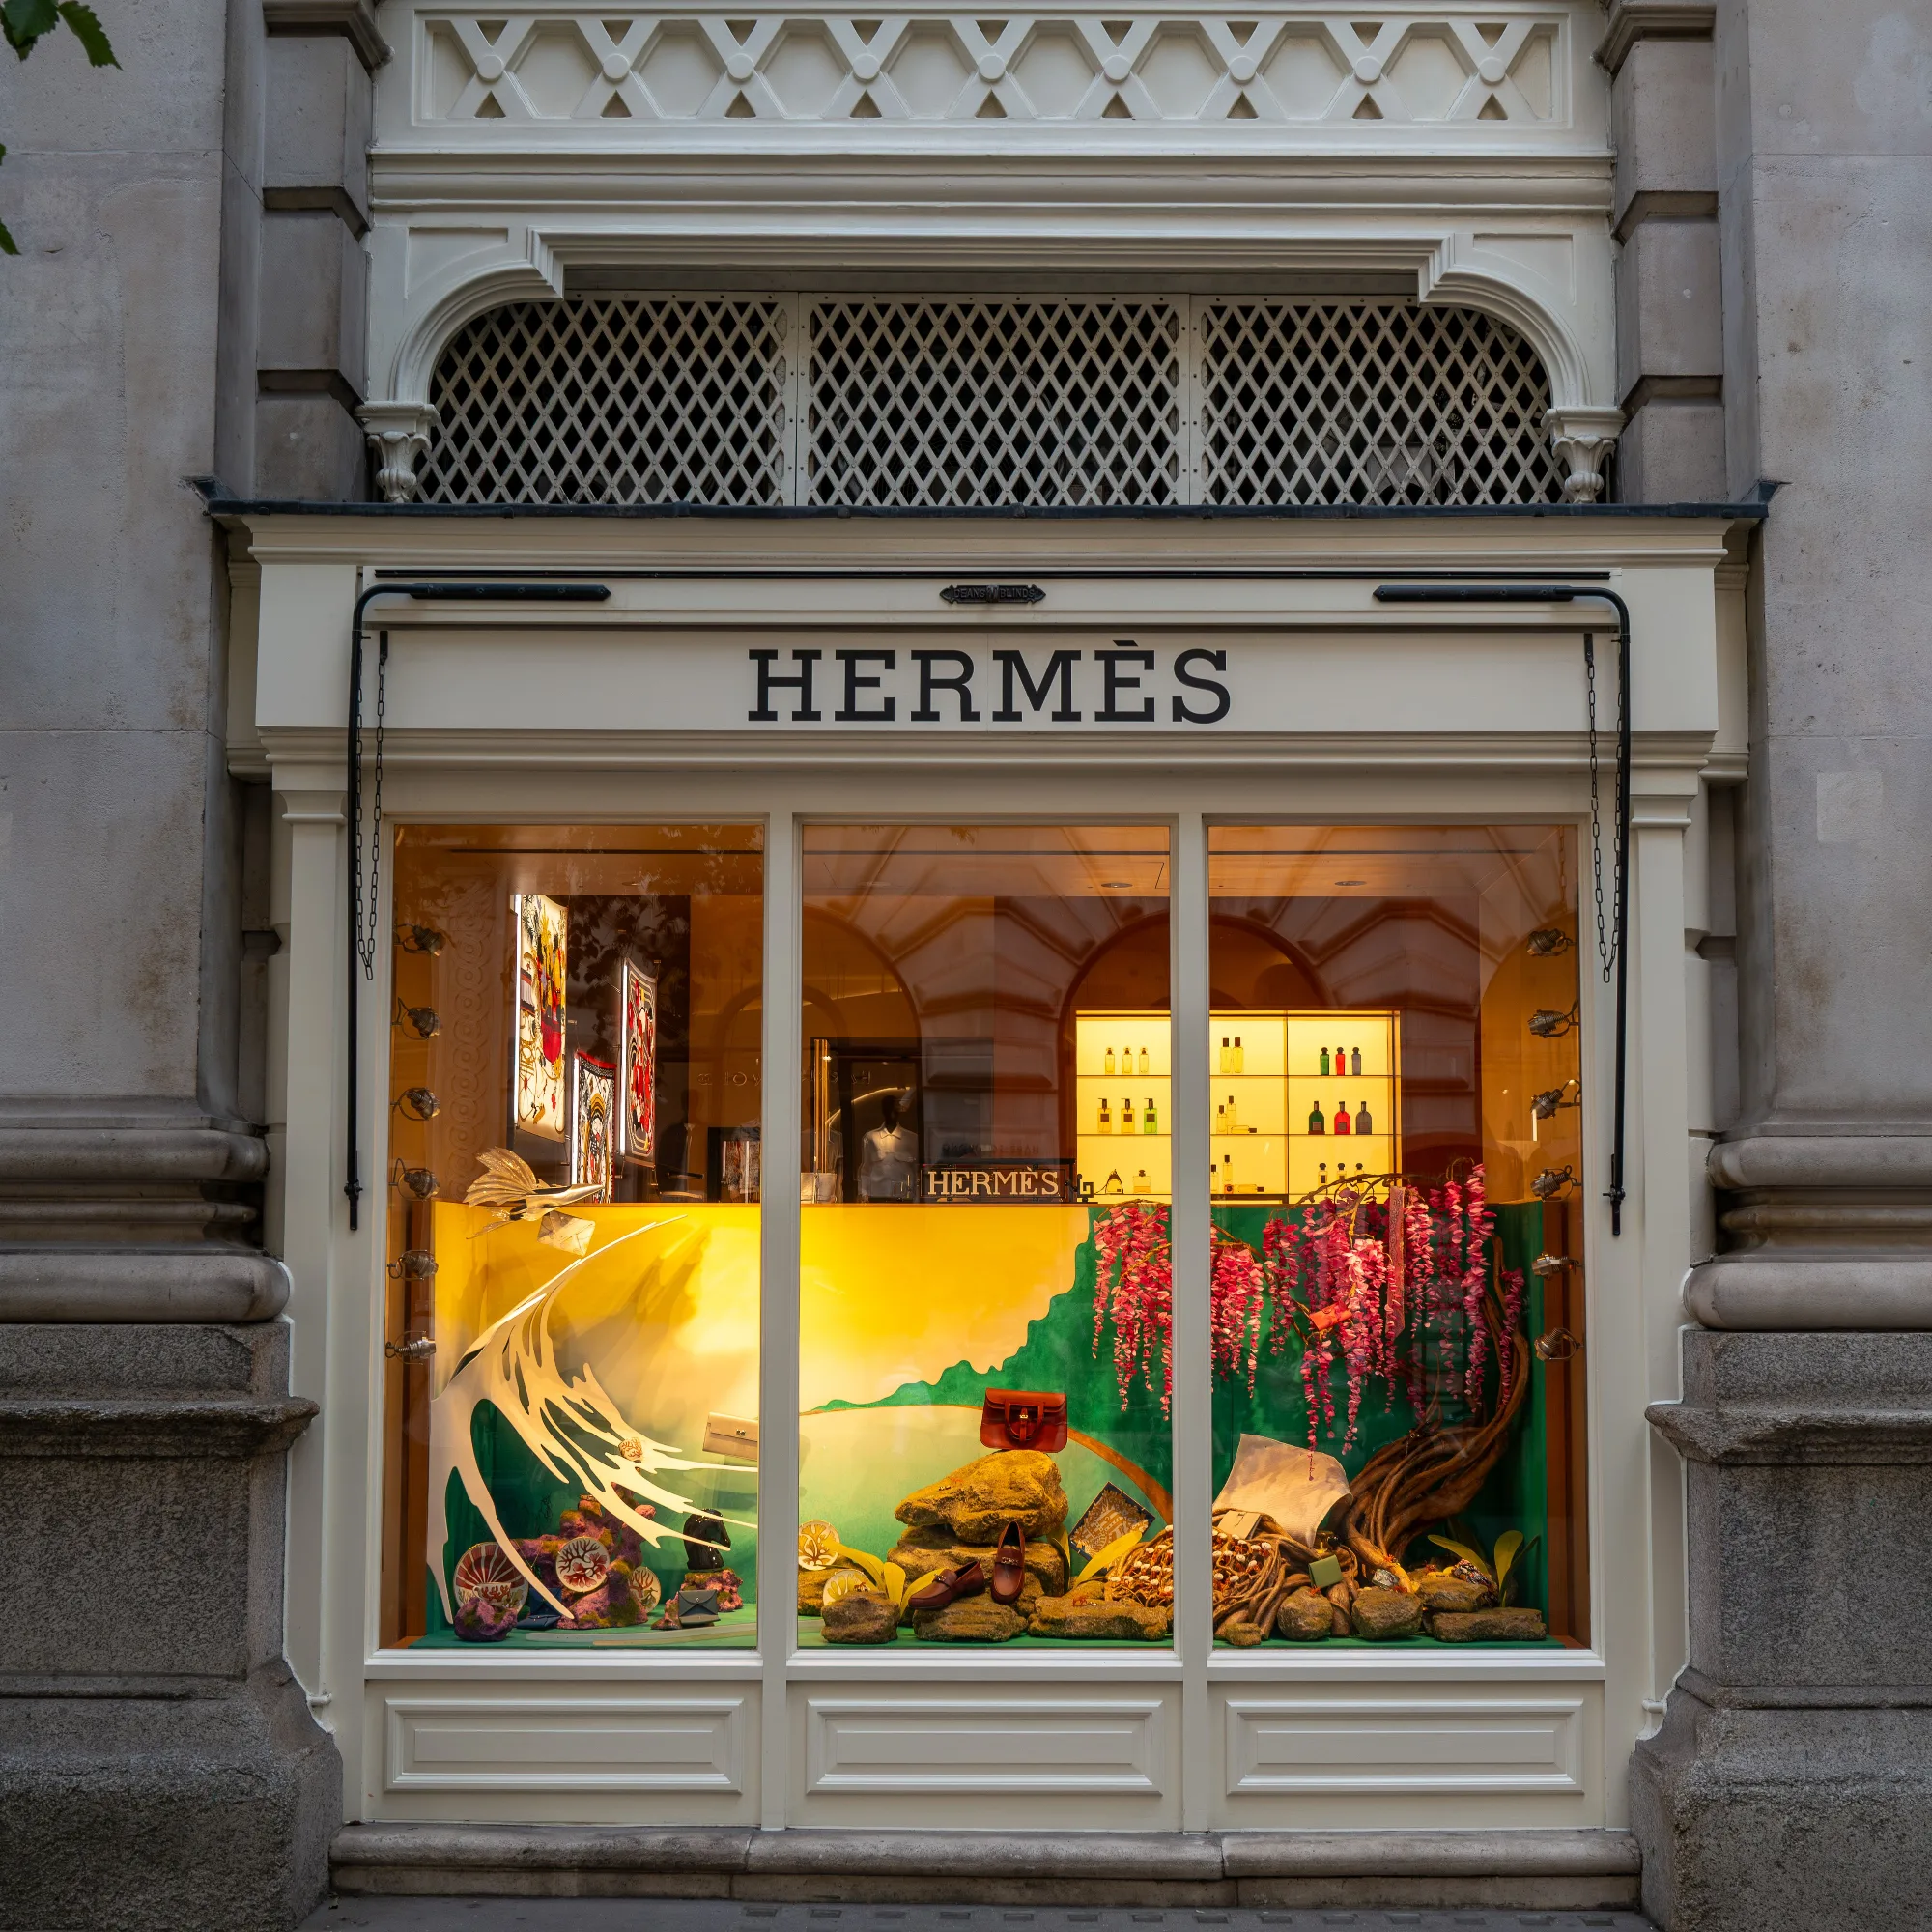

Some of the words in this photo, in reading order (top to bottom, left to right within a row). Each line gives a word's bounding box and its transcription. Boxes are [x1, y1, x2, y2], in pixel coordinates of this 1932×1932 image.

[953, 587, 985, 598] DEANS
[1000, 587, 1035, 598] BLINDS
[748, 640, 1231, 724] HERMÈS
[927, 1166, 1059, 1195] HERMÈS
